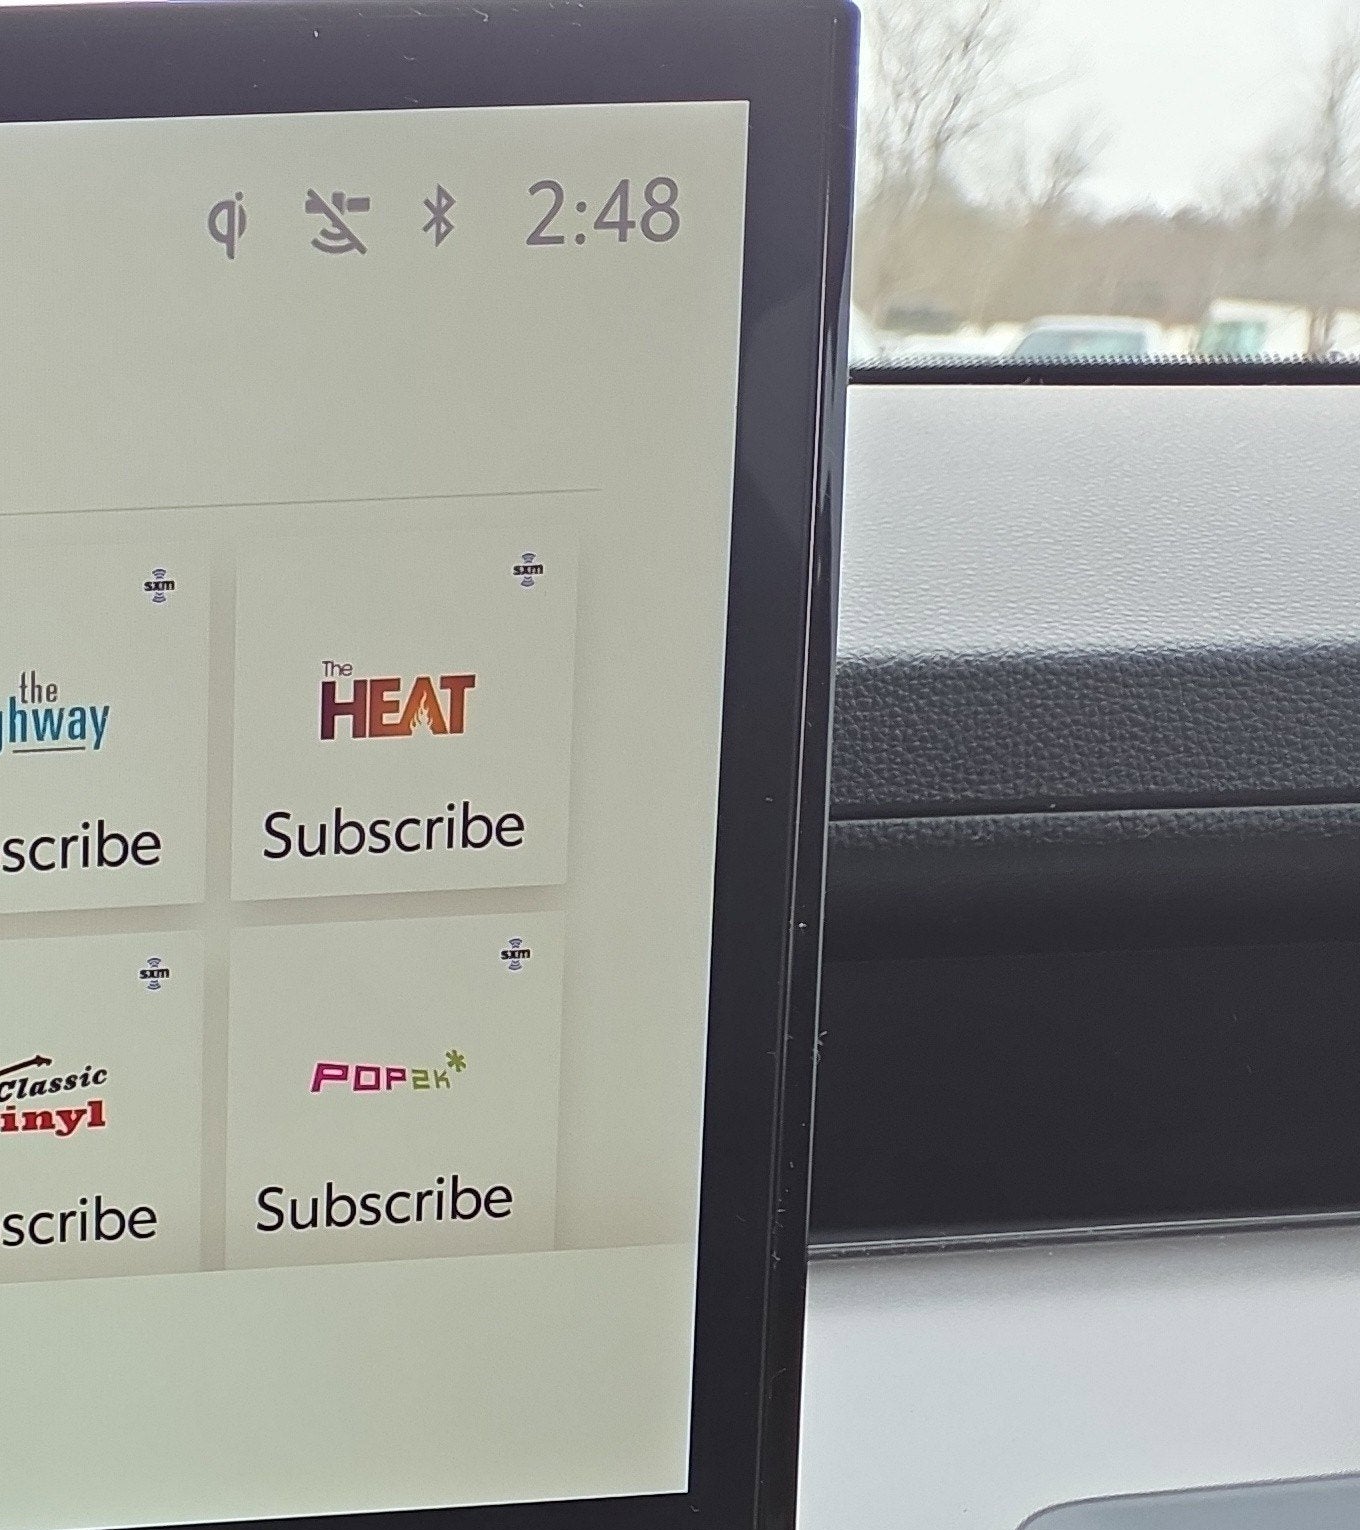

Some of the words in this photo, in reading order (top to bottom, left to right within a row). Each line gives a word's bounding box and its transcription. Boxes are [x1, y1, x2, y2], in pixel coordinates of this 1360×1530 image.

[525, 176, 680, 246] 2:48
[513, 563, 544, 576] sxm
[143, 579, 176, 592] sxm
[321, 660, 353, 677] The
[19, 670, 58, 704] the
[319, 673, 477, 741] HEAT
[263, 800, 525, 859] Subscribe
[500, 949, 531, 960] sxm
[139, 968, 170, 980] sxm
[256, 1174, 513, 1232] Subscribe
